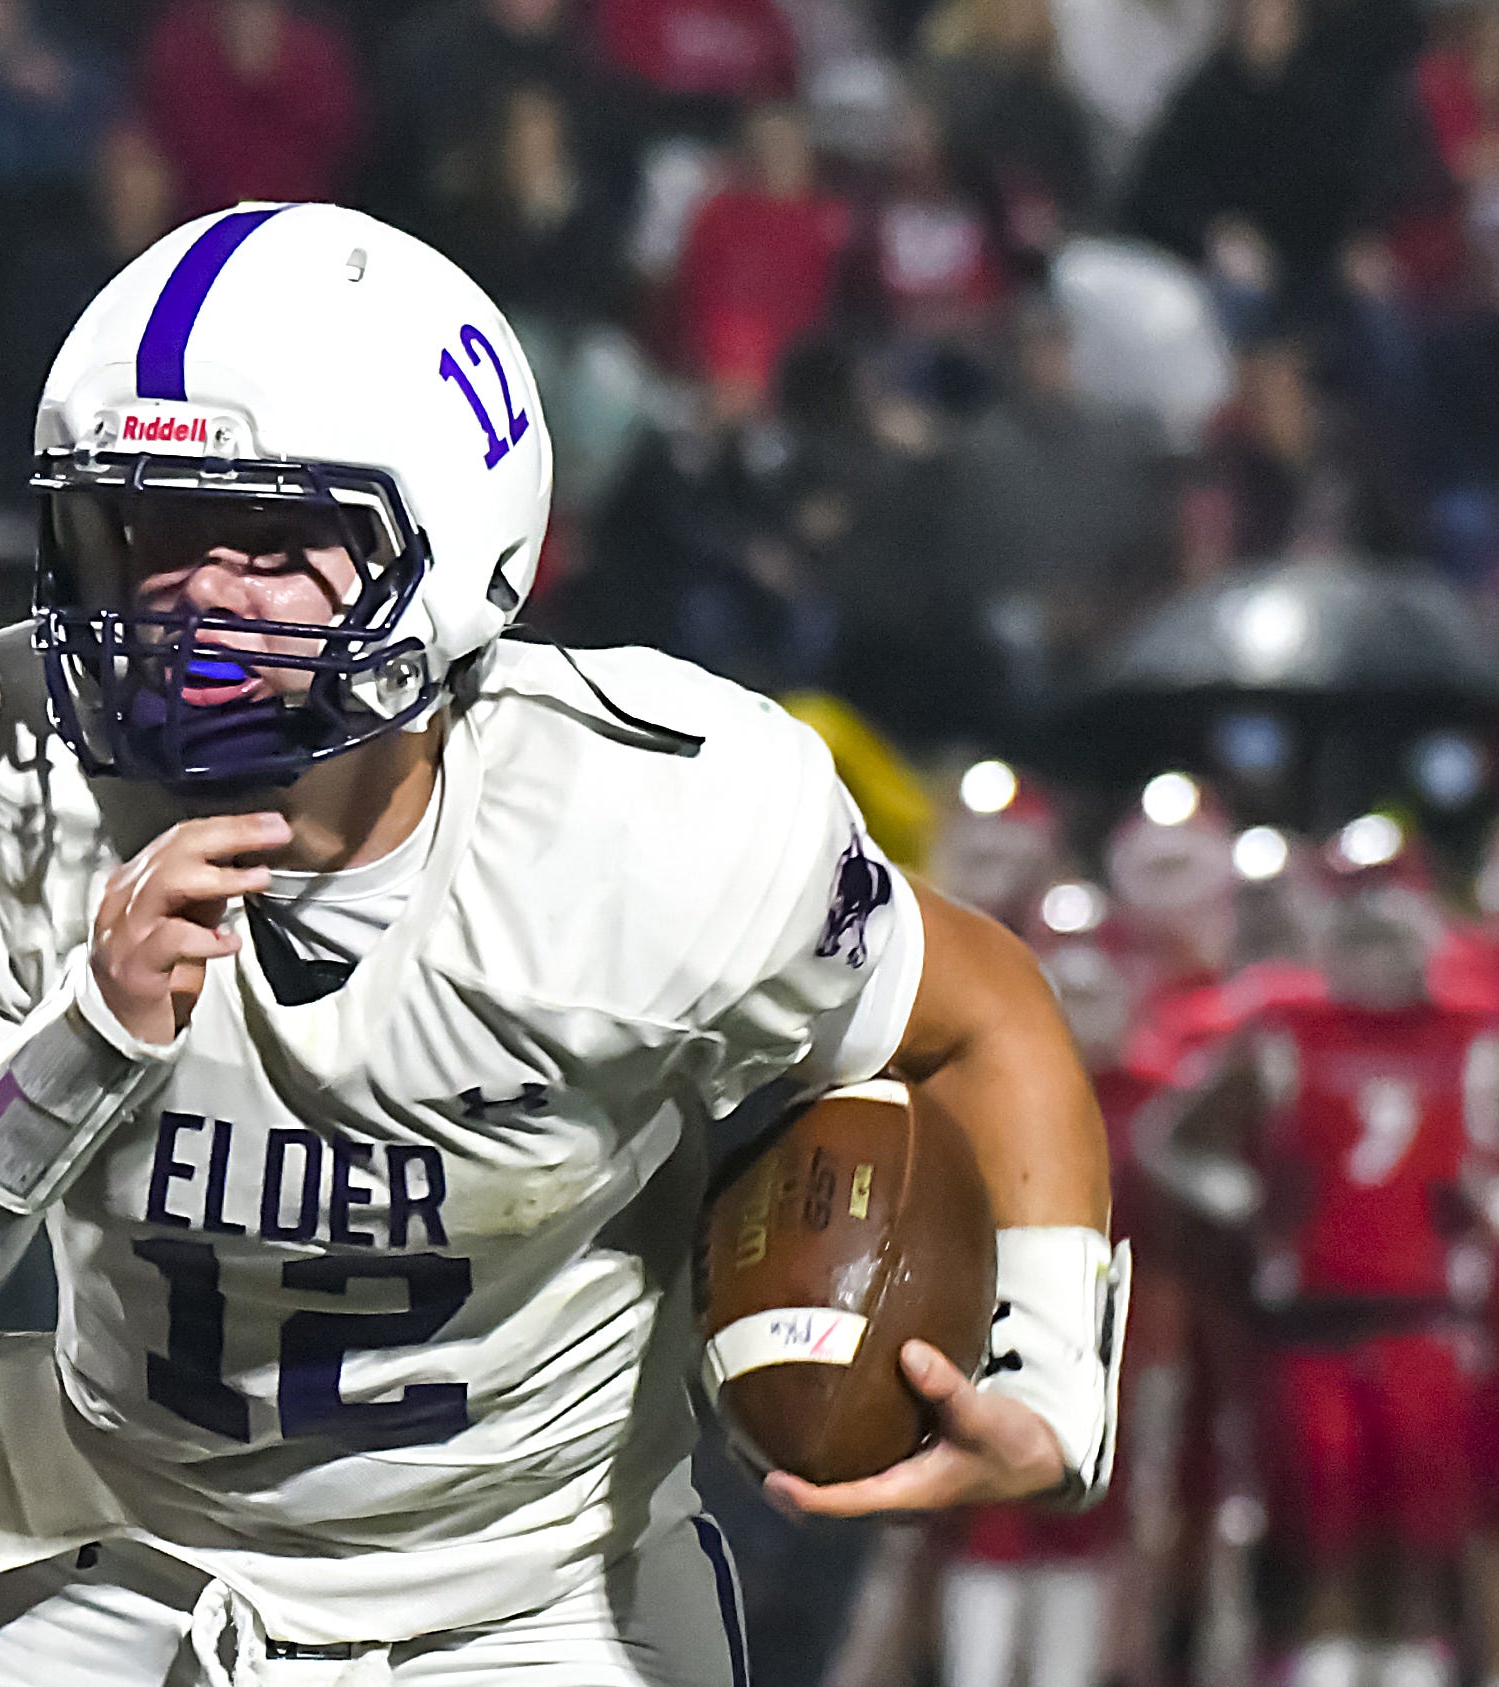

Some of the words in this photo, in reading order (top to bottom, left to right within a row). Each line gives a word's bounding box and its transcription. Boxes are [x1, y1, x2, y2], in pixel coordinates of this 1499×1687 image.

[122, 415, 207, 443] Riddell
[439, 323, 529, 470] 12
[146, 1110, 450, 1247] ELDER
[132, 1236, 474, 1444] 12
